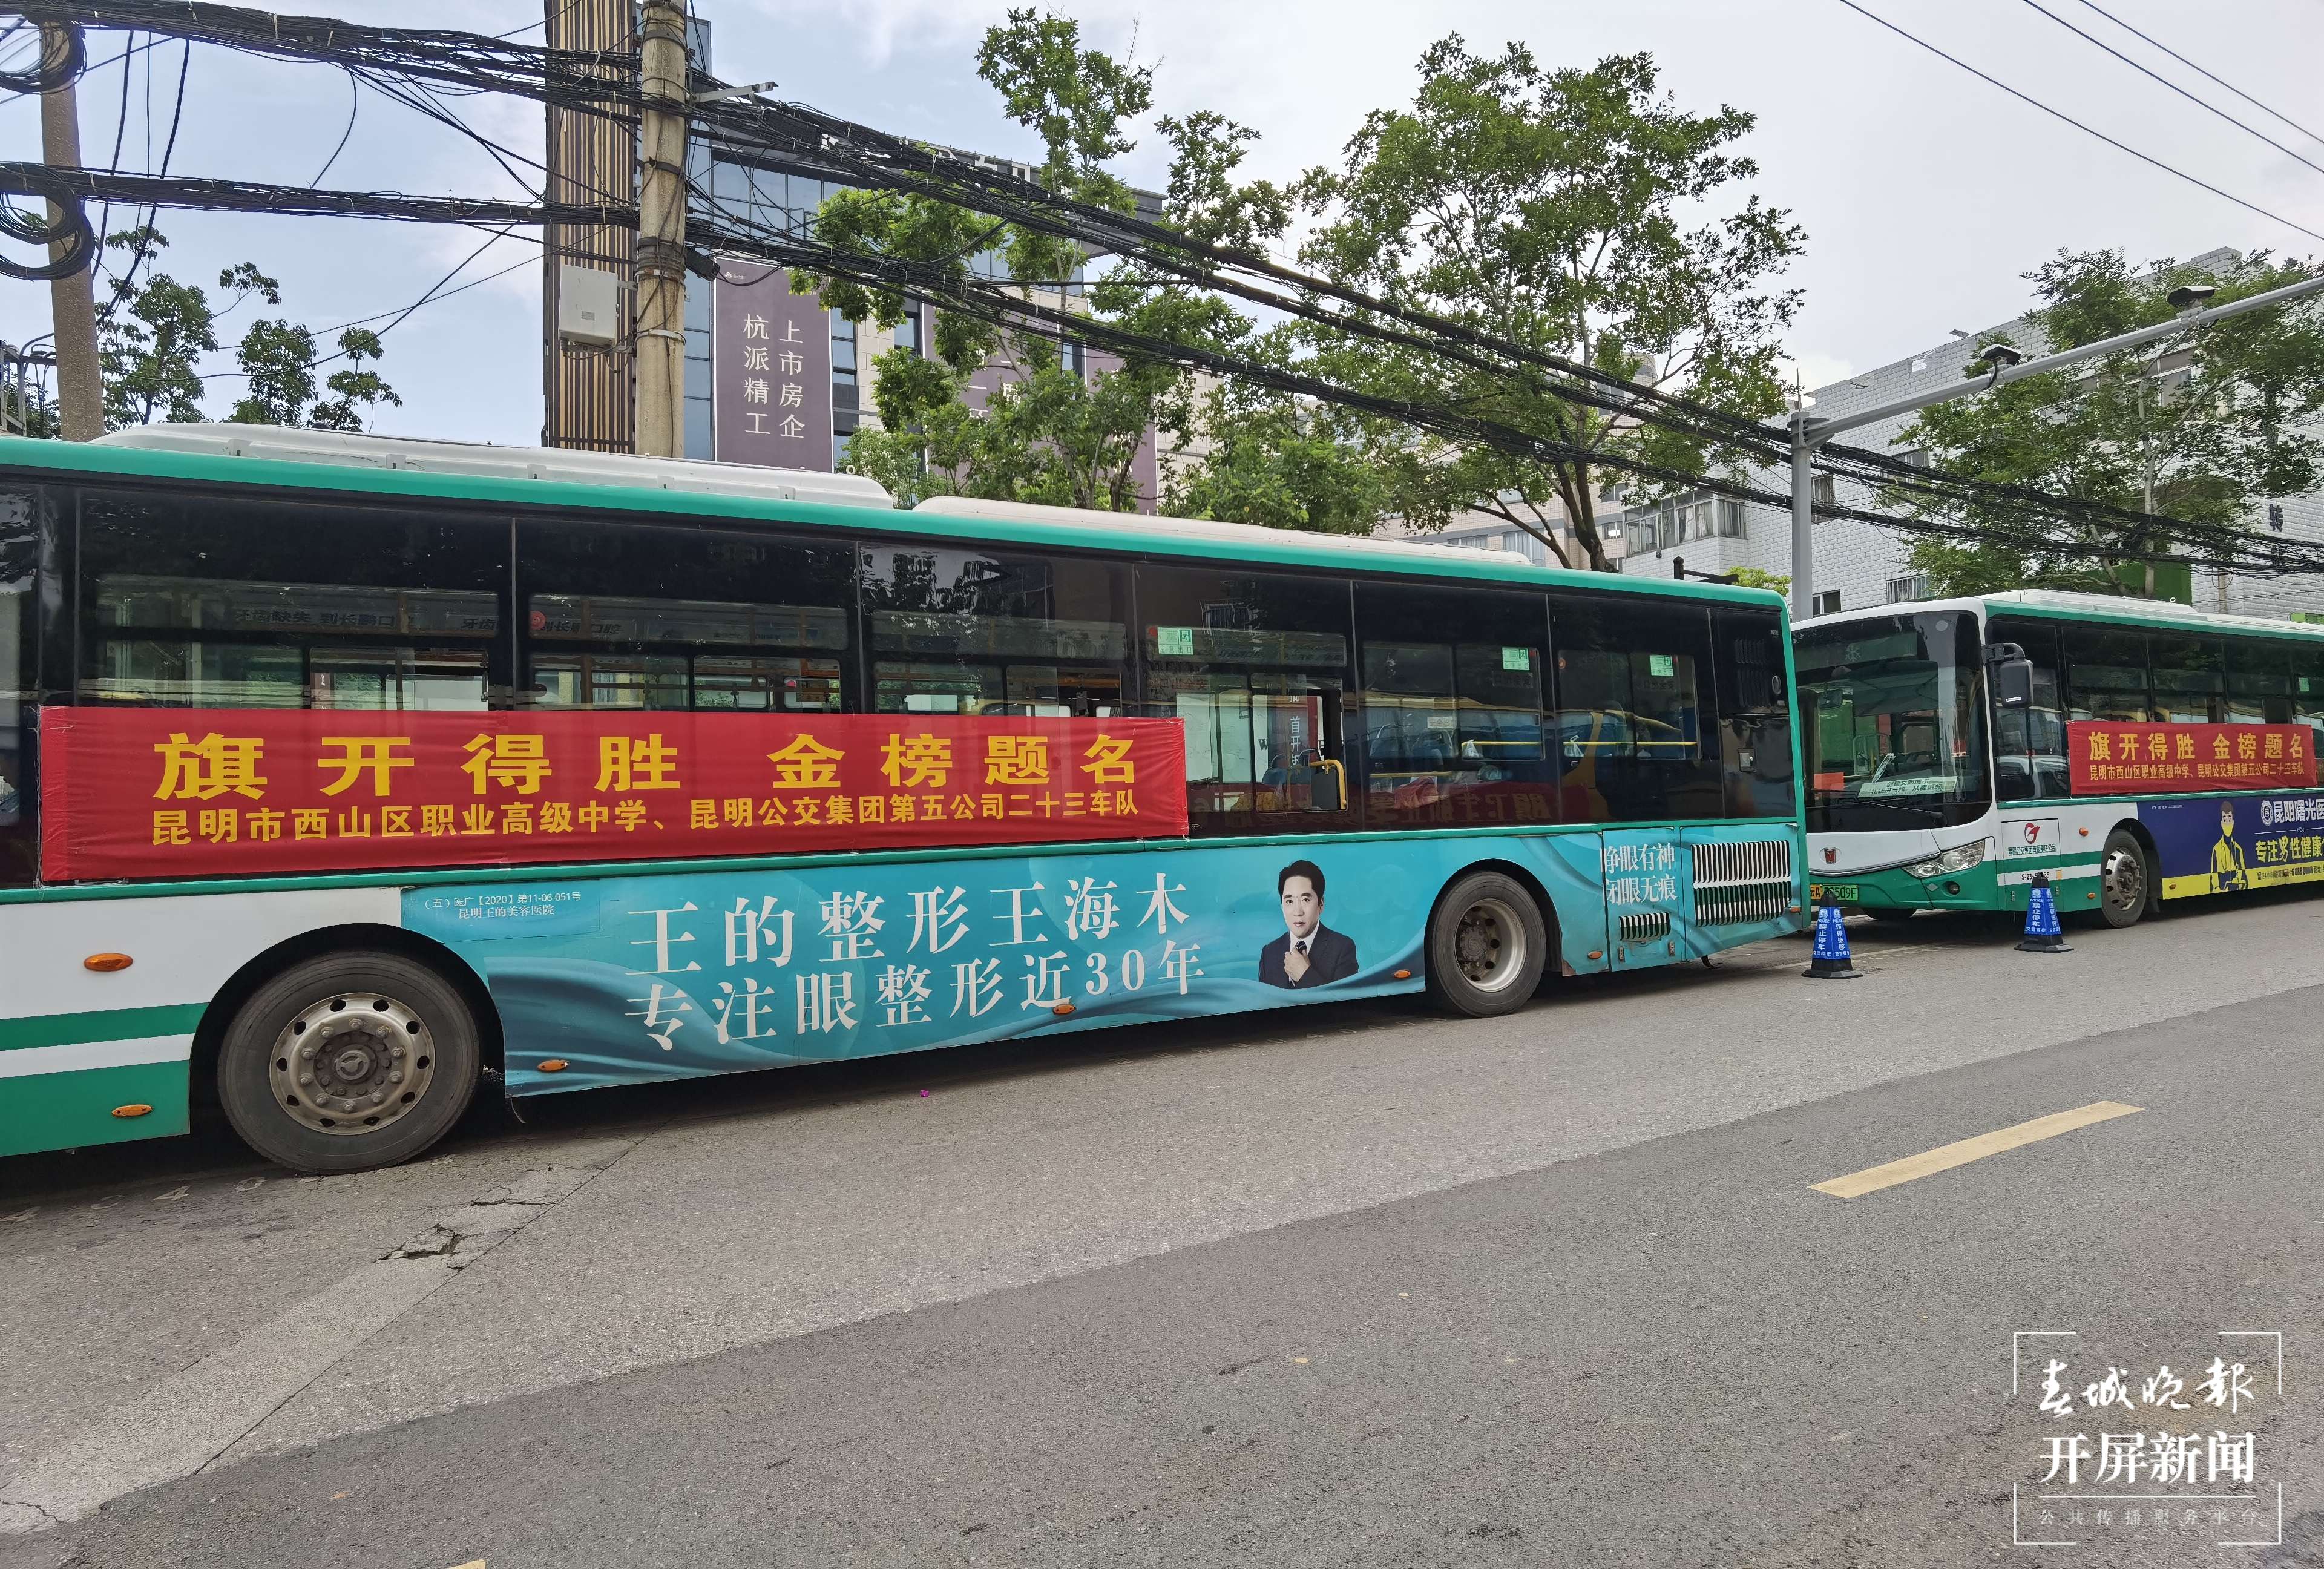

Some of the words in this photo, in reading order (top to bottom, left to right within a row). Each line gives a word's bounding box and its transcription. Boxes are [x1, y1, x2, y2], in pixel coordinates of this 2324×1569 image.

[743, 313, 770, 435] 杭派精工
[778, 319, 806, 438] 上市房企
[153, 732, 680, 800] 旗开得胜
[767, 733, 1135, 788] 金榜题名
[2088, 731, 2195, 761] 旗开得胜
[2212, 732, 2303, 760] 金榜题名
[2256, 835, 2324, 863] 专注男性健康
[458, 904, 554, 919] 昆明王的美容医院
[625, 872, 1190, 977] 王的整形王海木
[626, 940, 1204, 1051] 专注眼整形近30年
